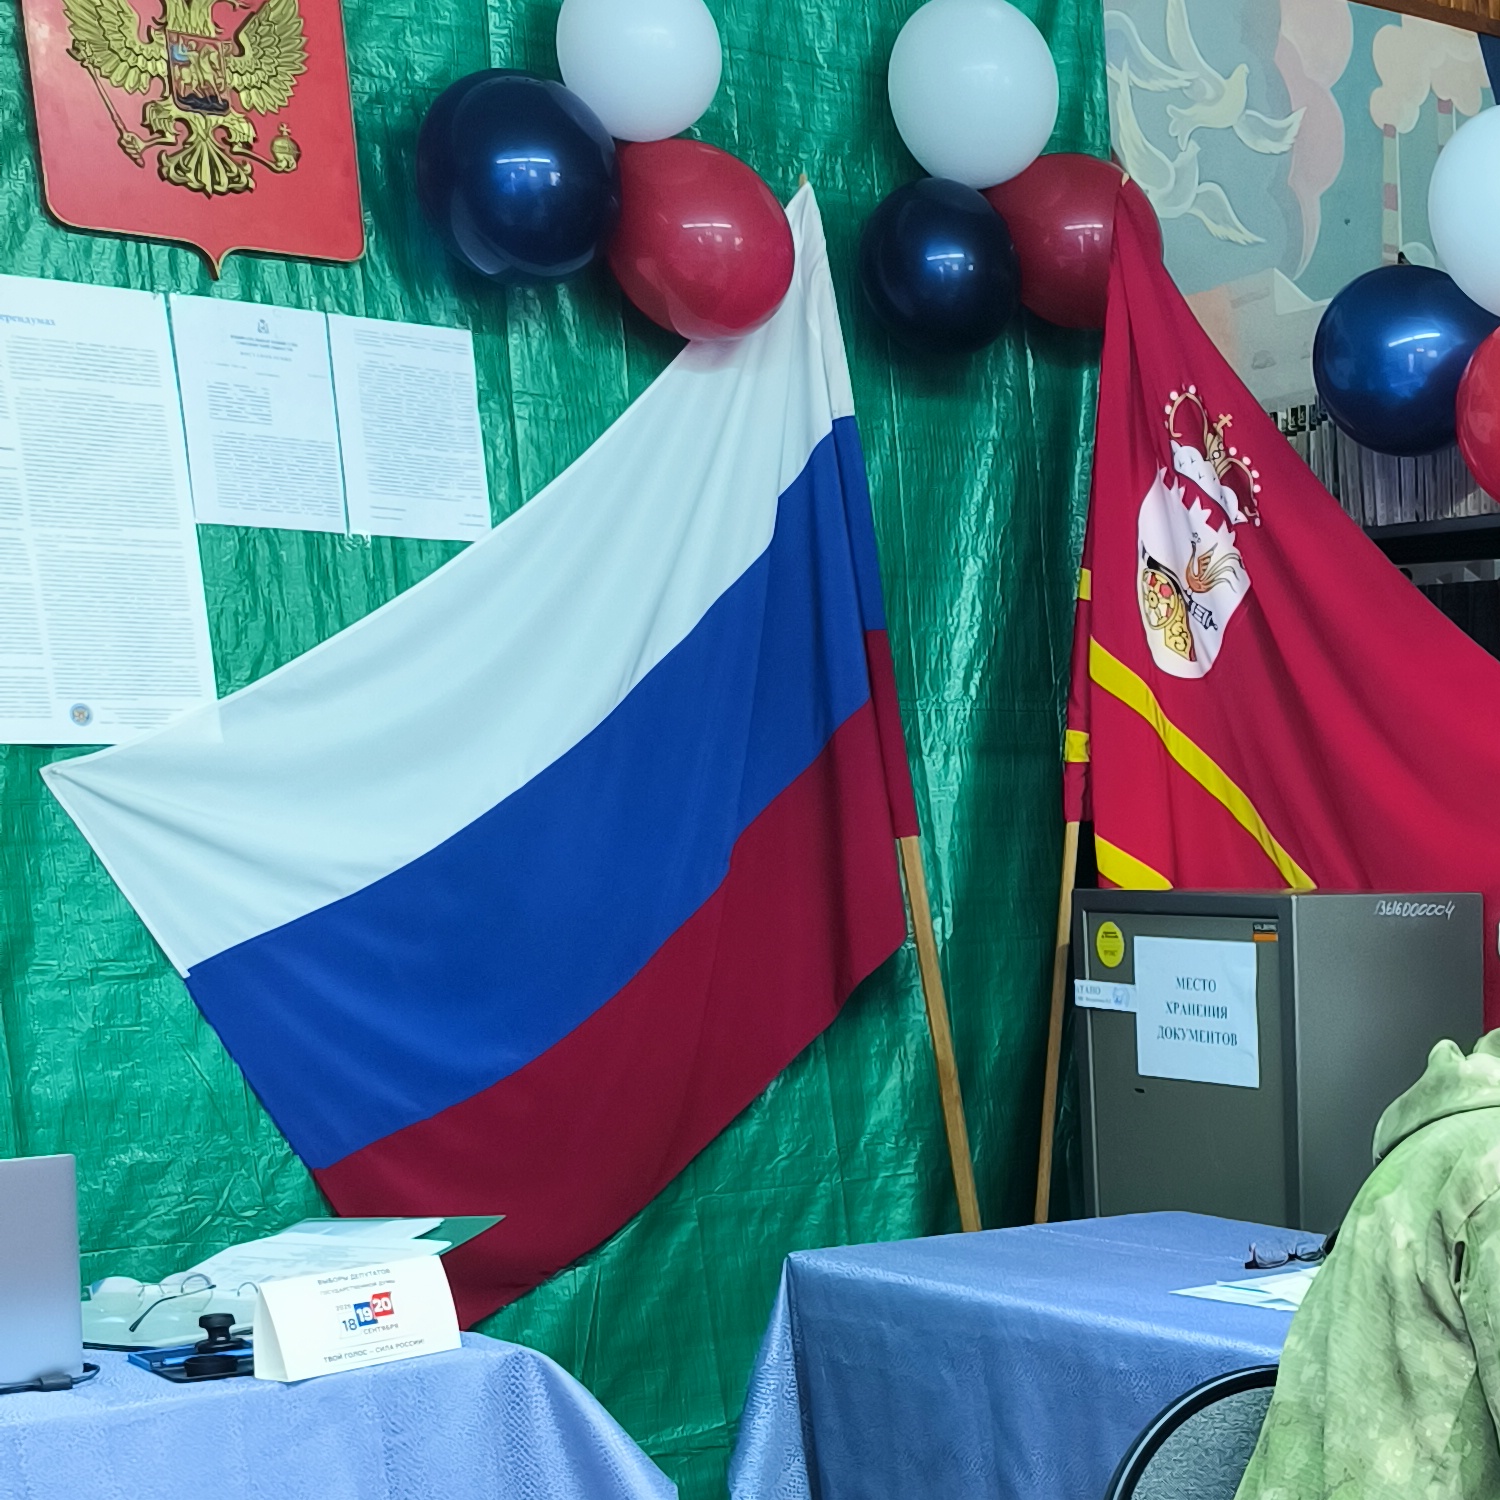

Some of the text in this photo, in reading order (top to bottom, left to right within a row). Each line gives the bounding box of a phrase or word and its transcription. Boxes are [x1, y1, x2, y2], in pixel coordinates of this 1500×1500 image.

[1175, 976, 1216, 992] МЕСТО
[1165, 1001, 1228, 1019] ХРАНЕНИЯ
[1157, 1025, 1238, 1046] ДОКУМЕНТОВ
[317, 1269, 390, 1285] ВЫБОРЫ ДЕПУТАТОВ
[342, 1297, 391, 1332] 18 19 20
[363, 1323, 399, 1335] СЕНТЯБРЯ
[324, 1354, 343, 1363] ТВОЙ
[344, 1350, 367, 1359] ГОЛОС
[375, 1345, 394, 1353] СИЛА
